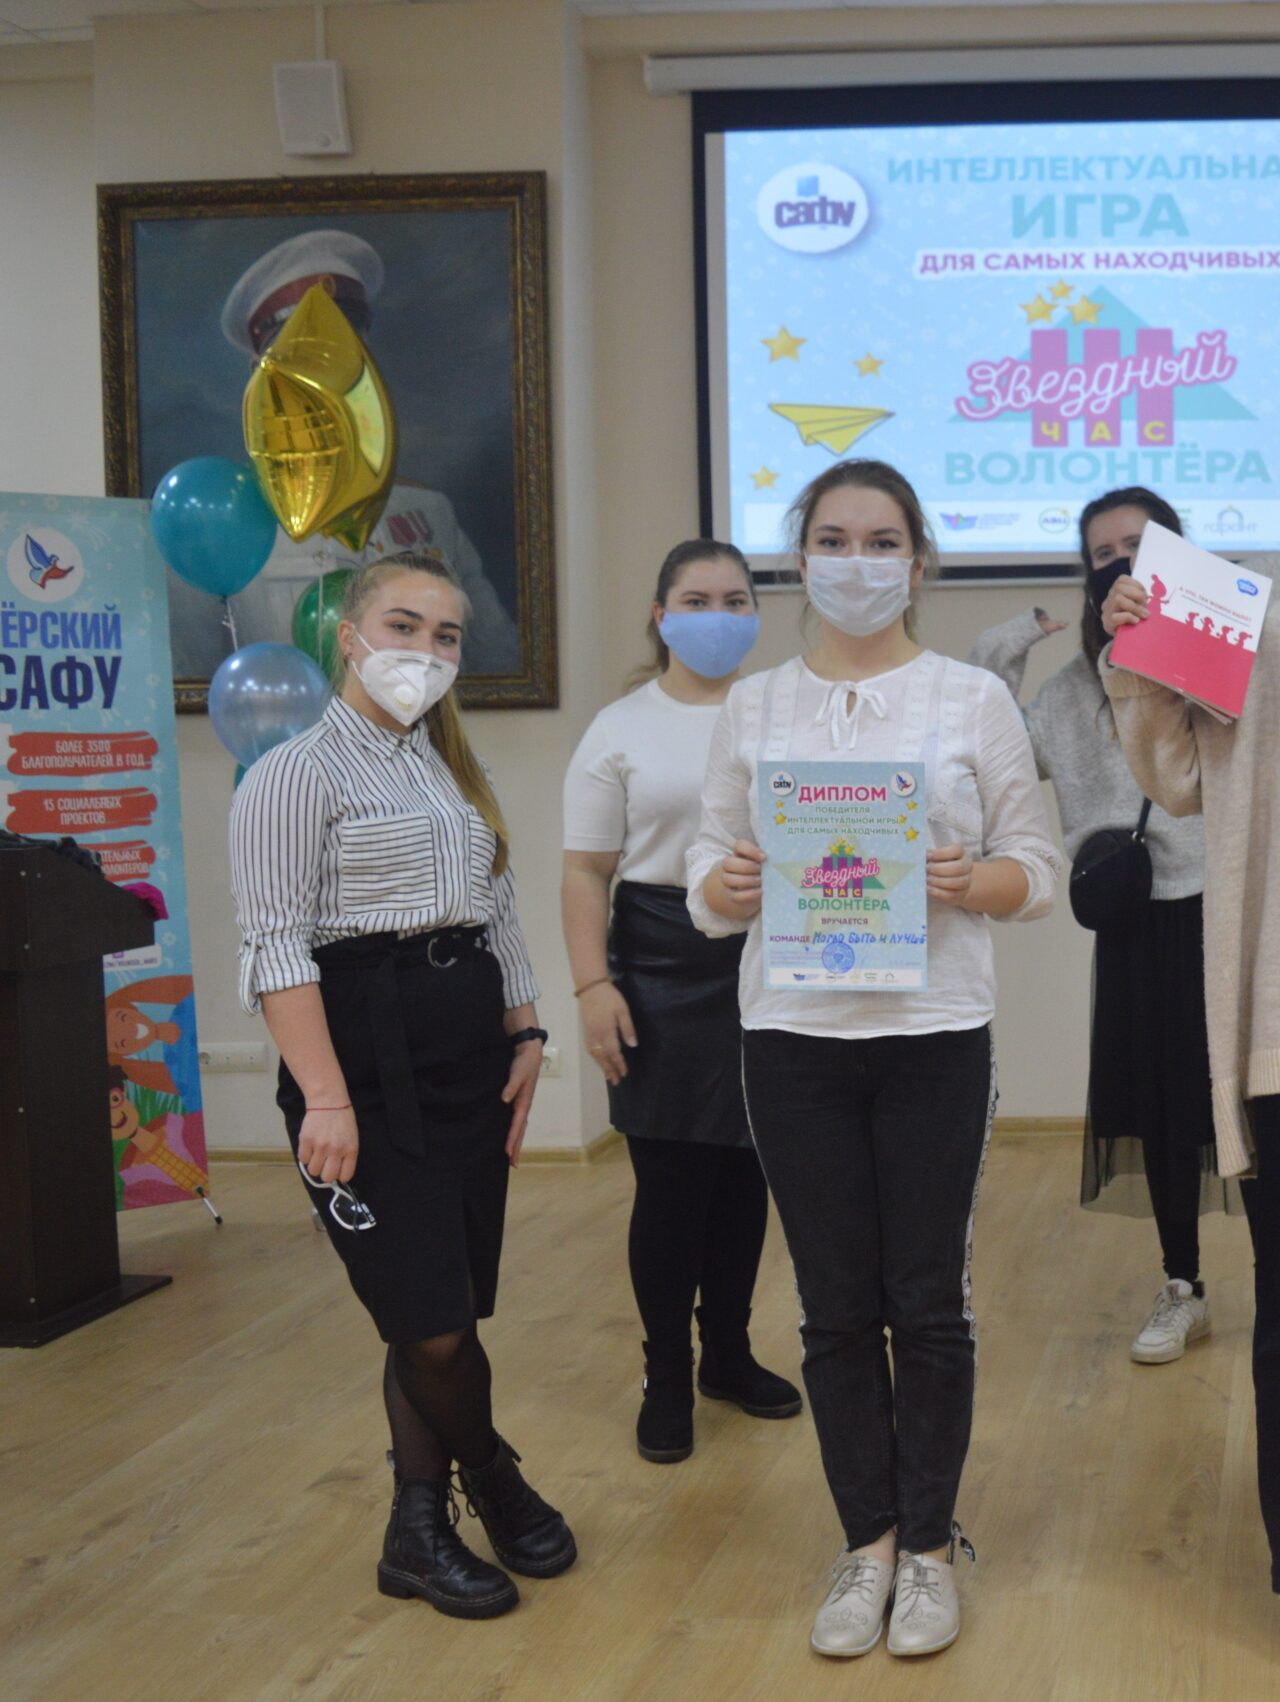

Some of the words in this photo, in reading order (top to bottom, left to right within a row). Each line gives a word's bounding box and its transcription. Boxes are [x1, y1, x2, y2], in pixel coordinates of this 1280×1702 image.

[1012, 193, 1189, 239] ИГРА
[919, 252, 975, 274] ДЛЯ
[983, 251, 1085, 271] САМЫХ
[944, 442, 1272, 485] ВОЛОНТЁРА
[0, 653, 122, 710] САФУ
[55, 740, 83, 753] БОЛЕЕ
[87, 739, 112, 752] 3500
[21, 754, 114, 769] БЛАГОПОЛУЧАТЕЛЕЙ
[116, 754, 124, 767] В
[126, 753, 146, 767] ГОД
[798, 785, 887, 804] ДИПЛОМ
[43, 798, 54, 811] 15
[57, 796, 122, 810] СОЦИАЛЬНЫХ
[815, 806, 871, 815] ПОБЕДИТЕЛЯ
[60, 811, 106, 826] ПРОЕКТОВ
[787, 816, 875, 825] ИНТЕЛЛЕКТУАЛЬНОЙ
[876, 816, 899, 825] ИГРЫ
[787, 827, 806, 836] ДЛЯ
[807, 826, 839, 835] САМЫХ
[840, 826, 899, 836] НАХОДЧИВЫХ
[824, 887, 863, 897] ЧАС
[798, 897, 891, 911] ВОЛОНТЁРА
[821, 917, 869, 926] ВРУЧАЕТСЯ
[769, 935, 810, 943] КОМАНДЕ
